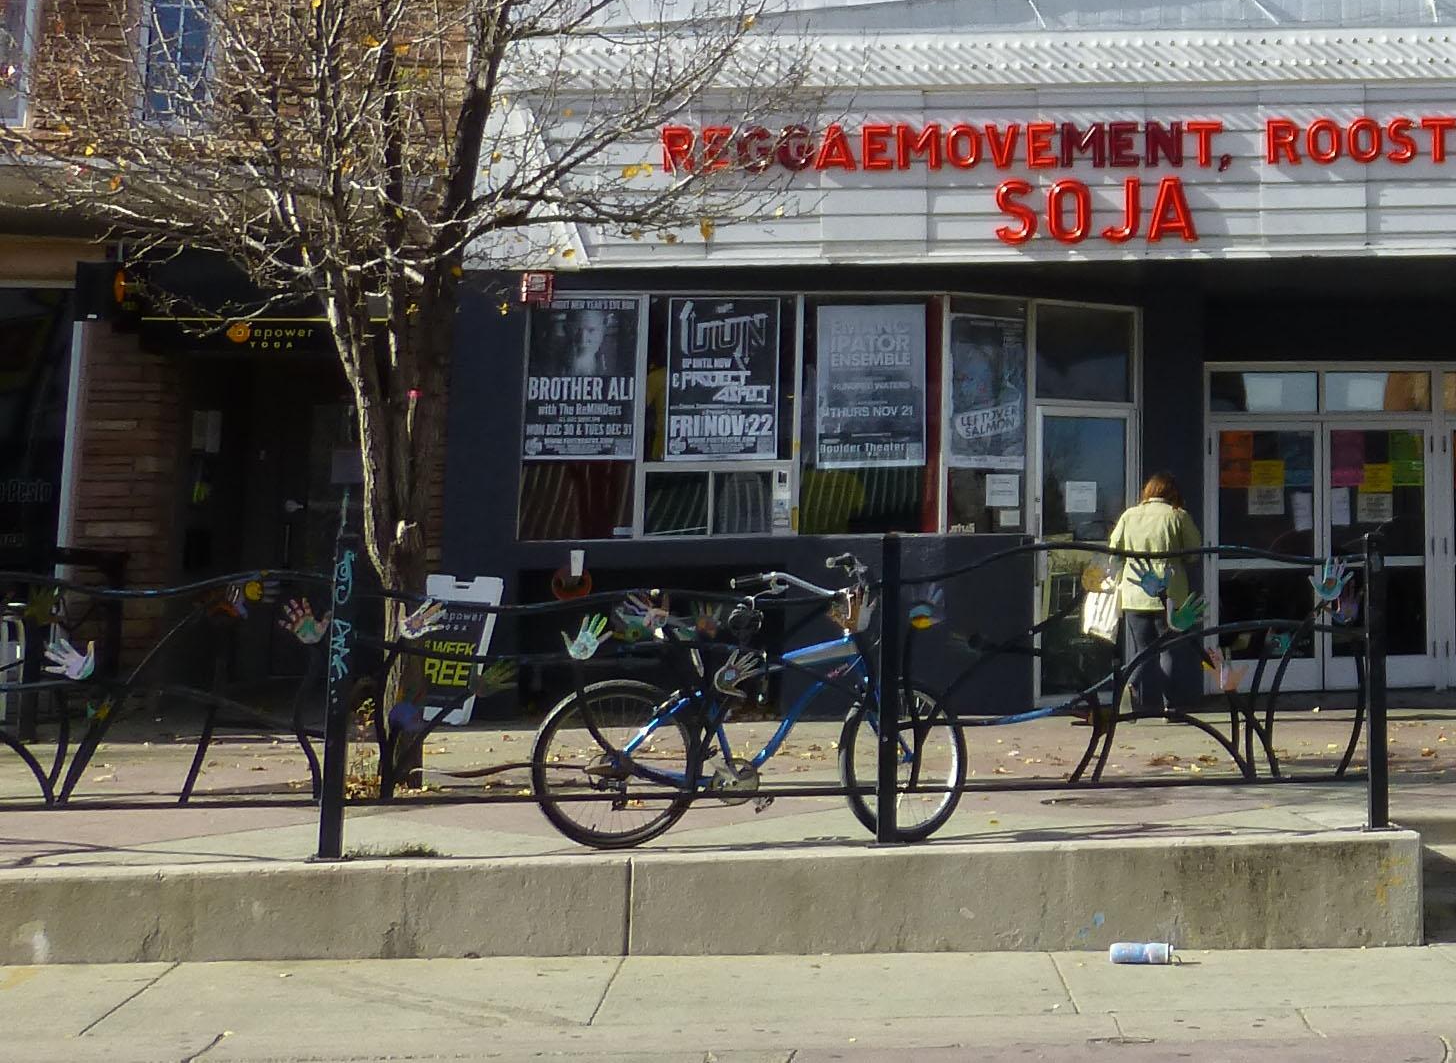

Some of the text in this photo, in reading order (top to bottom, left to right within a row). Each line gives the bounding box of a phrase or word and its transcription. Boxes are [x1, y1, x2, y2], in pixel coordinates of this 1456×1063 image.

[995, 175, 1201, 245] SOJA
[250, 341, 293, 349] YOGA
[830, 352, 912, 368] ENSEMBLE
[527, 376, 635, 401] BROTHER ALI
[538, 403, 557, 416] with
[559, 403, 574, 416] The
[829, 404, 914, 418] THURS NOV 21
[526, 424, 633, 436] MON DEC 30 & TUES DEC 31
[670, 414, 774, 438] FRI NOV 22
[965, 417, 1016, 437] SALMON
[819, 441, 905, 454] Boulder Theater
[433, 640, 477, 657] WEEK
[424, 657, 471, 687] REE
